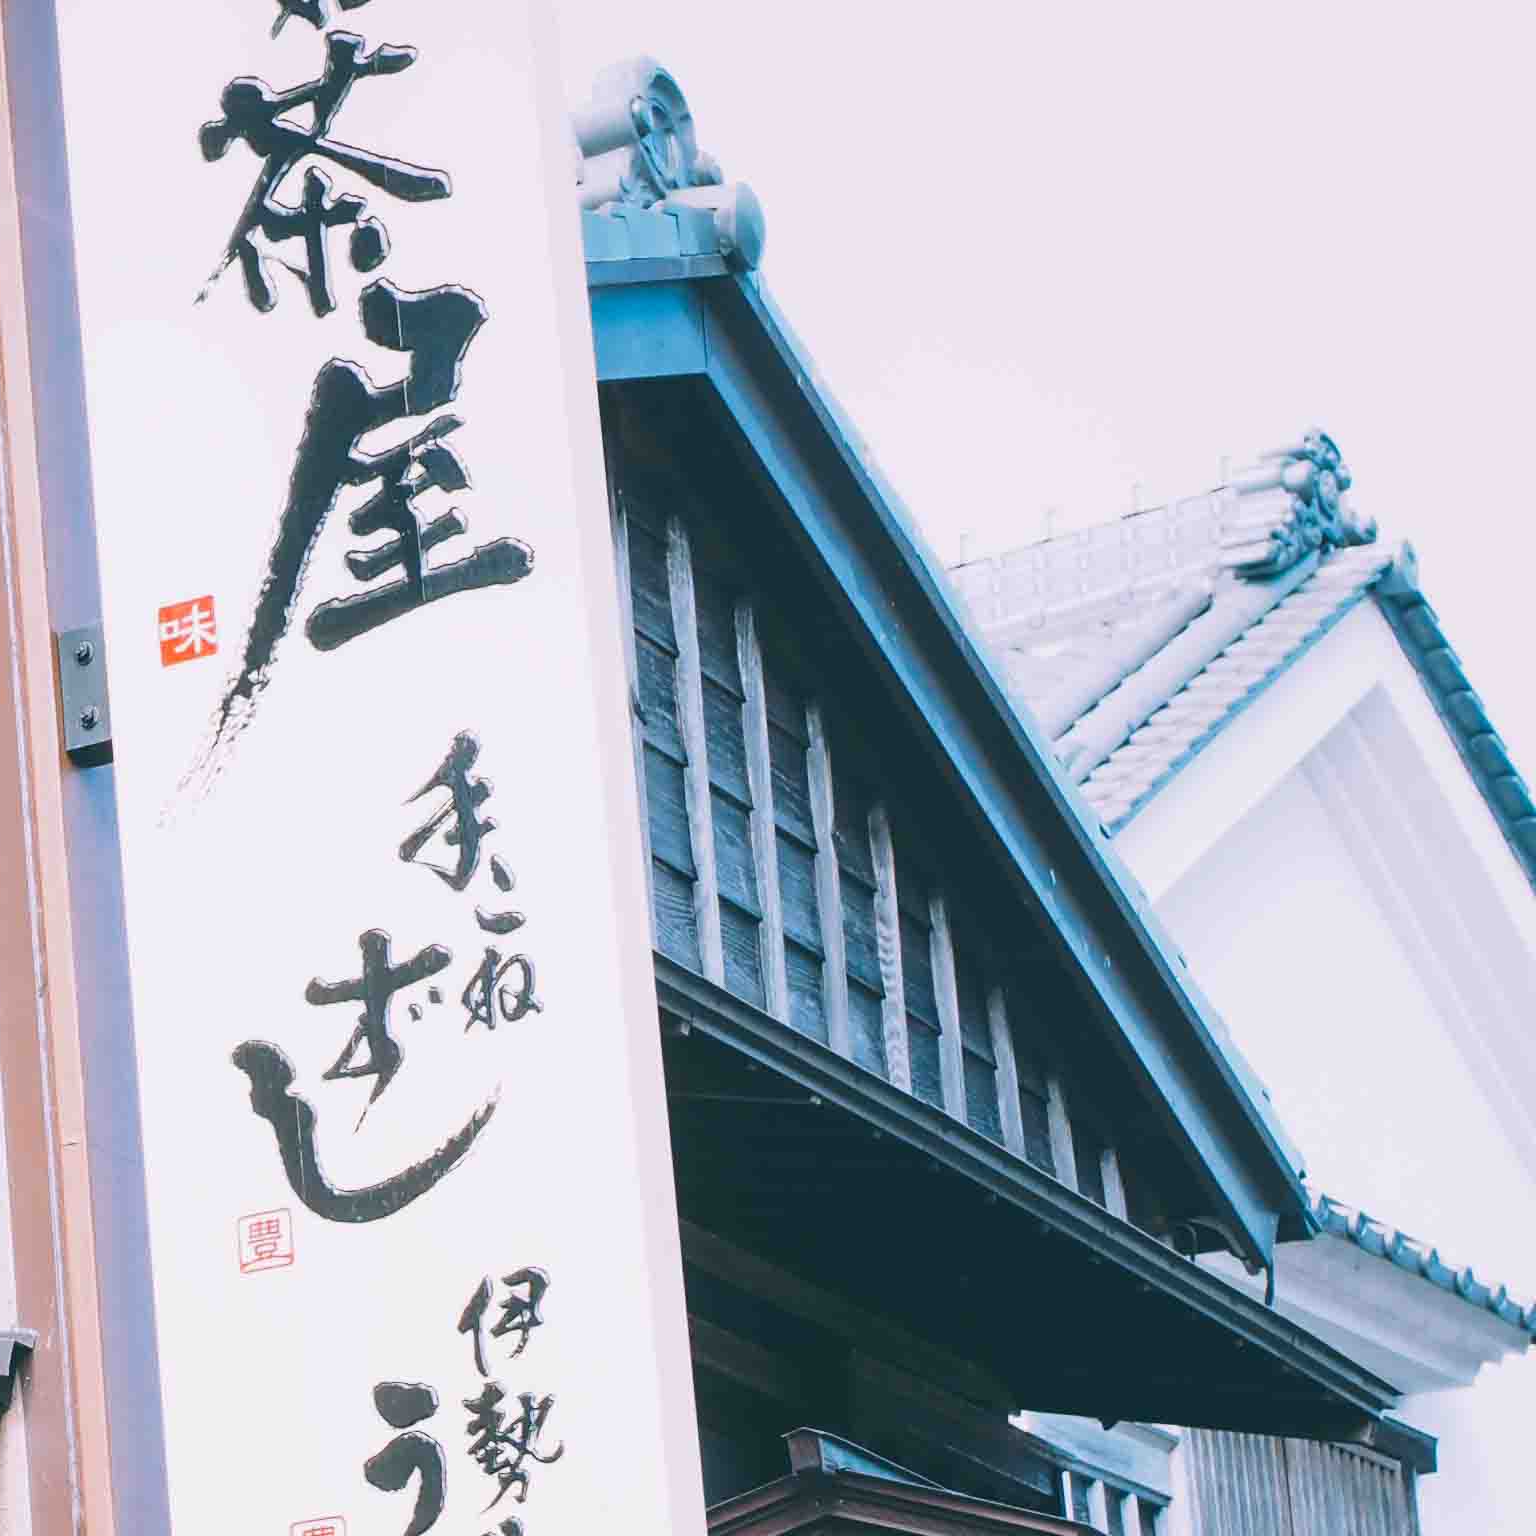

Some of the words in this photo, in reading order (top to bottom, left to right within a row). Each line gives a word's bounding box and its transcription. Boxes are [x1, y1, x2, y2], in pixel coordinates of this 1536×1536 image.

[157, 0, 535, 828] 茶屋
[159, 606, 218, 658] 味
[456, 1266, 564, 1512] 伊勢
